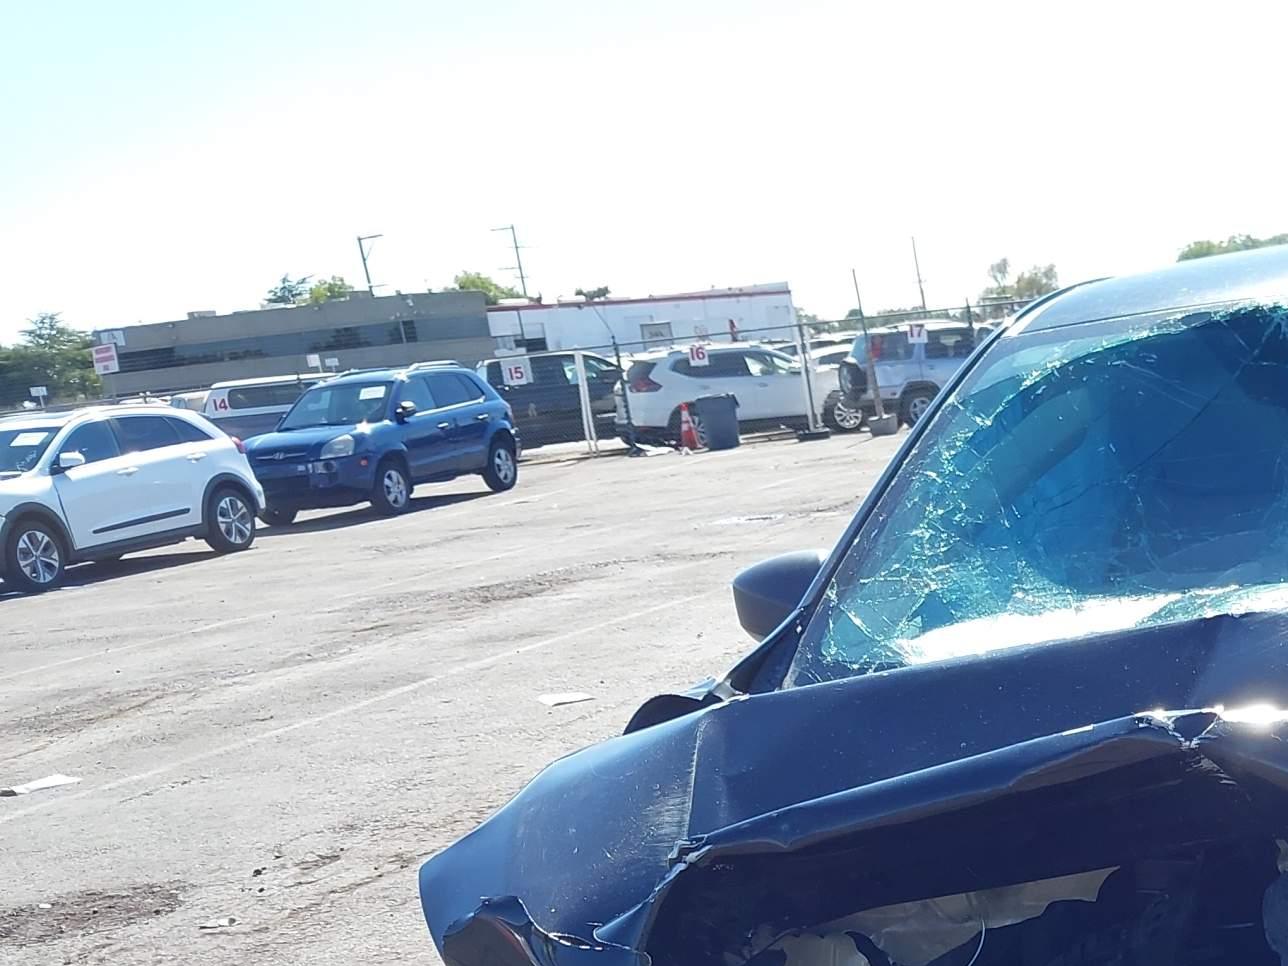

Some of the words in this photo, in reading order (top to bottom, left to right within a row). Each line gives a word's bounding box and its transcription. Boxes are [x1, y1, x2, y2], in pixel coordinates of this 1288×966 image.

[909, 323, 925, 338] 17
[690, 346, 706, 361] 16
[507, 366, 525, 381] 15
[212, 398, 229, 411] 14
